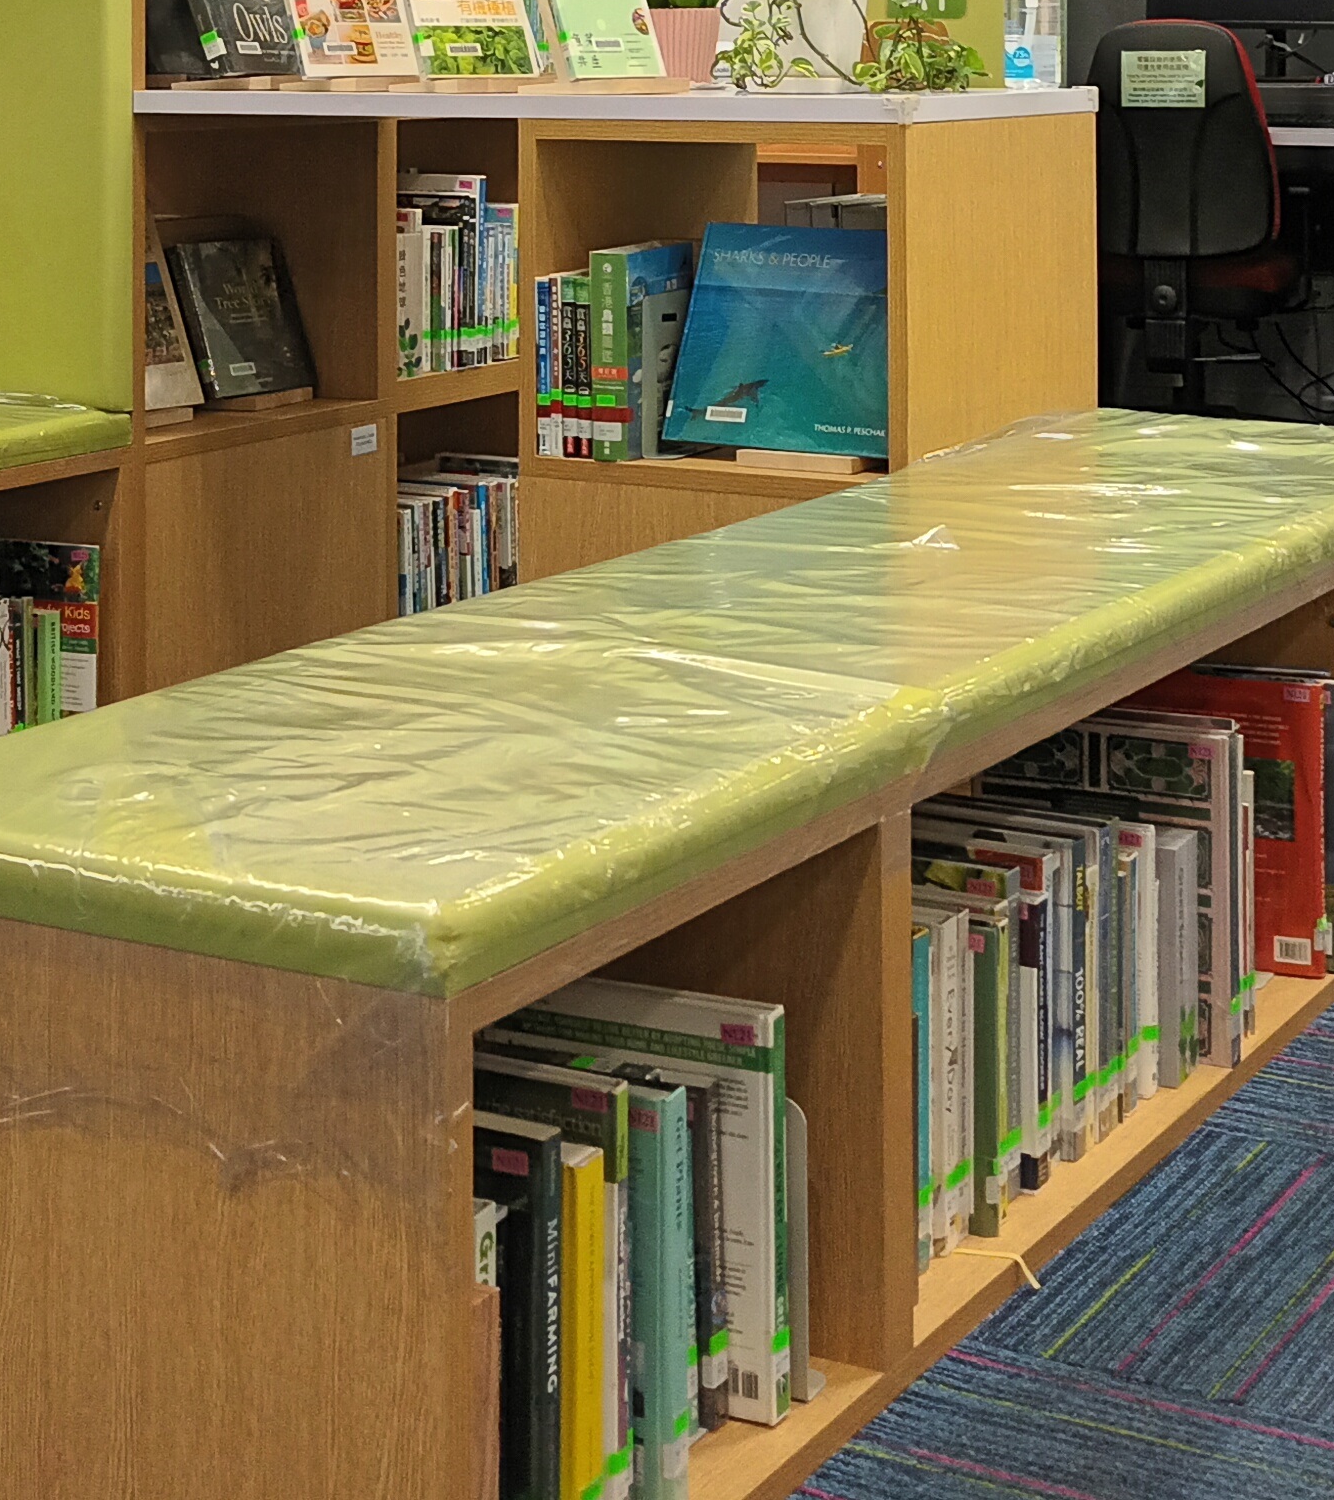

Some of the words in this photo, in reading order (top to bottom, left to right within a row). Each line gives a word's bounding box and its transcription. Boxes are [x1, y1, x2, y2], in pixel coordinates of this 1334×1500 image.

[233, 2, 289, 45] Owls
[712, 246, 765, 266] SHARKS
[767, 252, 780, 266] &
[781, 251, 832, 269] PEOPLE
[813, 423, 846, 434] THOMAS
[853, 427, 887, 437] PESCHAK
[61, 622, 91, 635] ojects
[64, 605, 91, 620] Kids
[1073, 967, 1085, 1021] 100%
[1073, 1025, 1085, 1073] REAL
[478, 1230, 495, 1286] Gr
[545, 1216, 560, 1395] MiniFARMING
